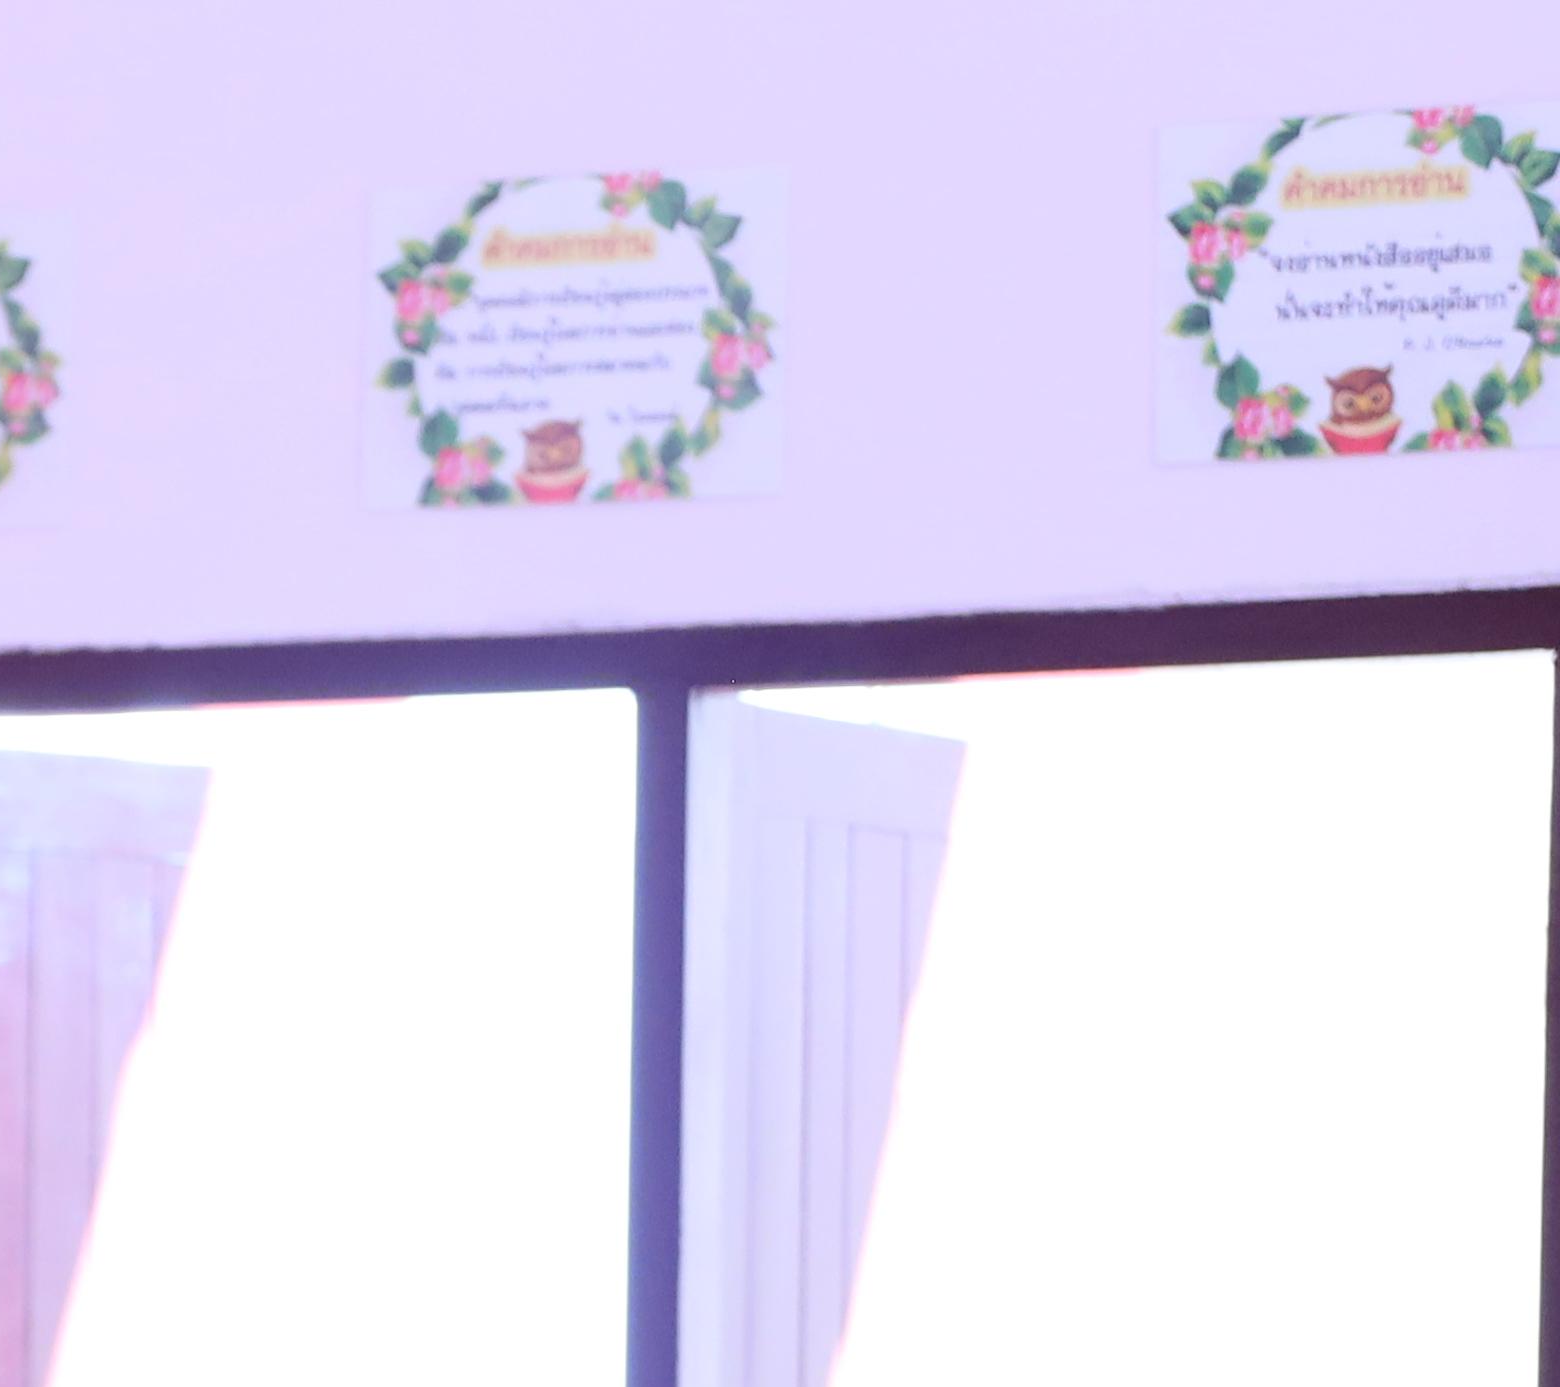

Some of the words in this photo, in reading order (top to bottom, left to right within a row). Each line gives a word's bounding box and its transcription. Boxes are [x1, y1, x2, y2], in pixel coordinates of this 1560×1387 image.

[1282, 160, 1467, 206] คำคมการอ่าน
